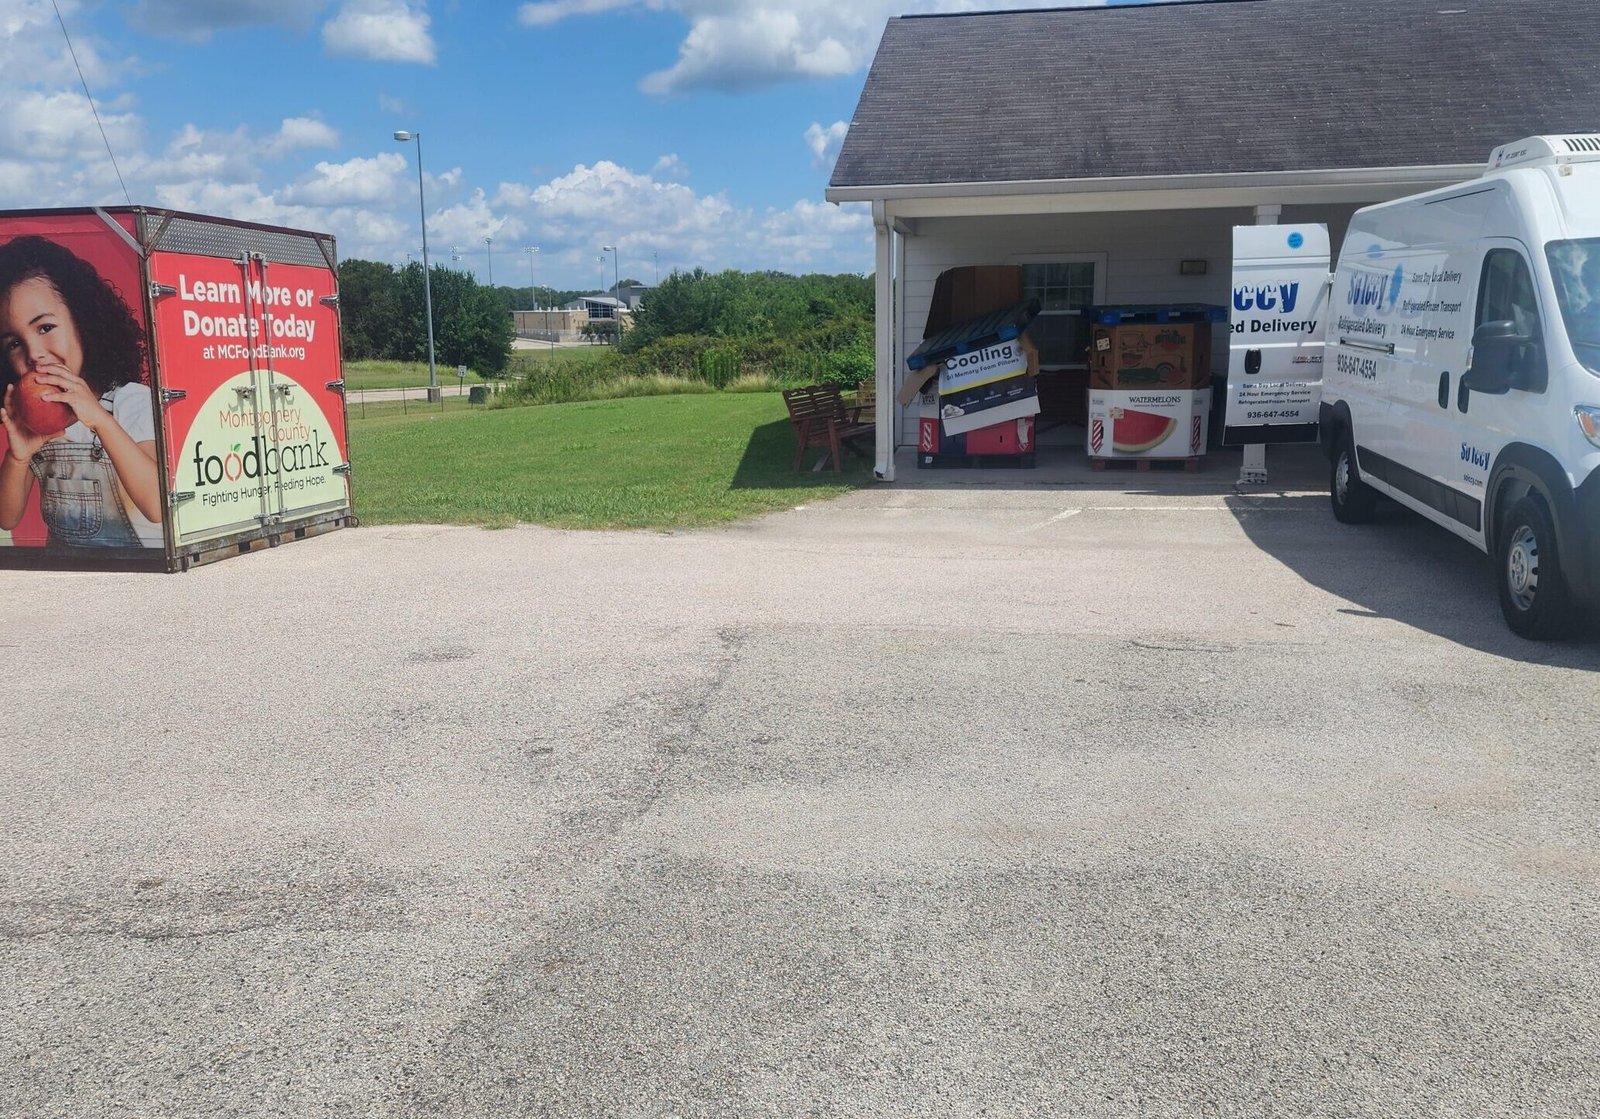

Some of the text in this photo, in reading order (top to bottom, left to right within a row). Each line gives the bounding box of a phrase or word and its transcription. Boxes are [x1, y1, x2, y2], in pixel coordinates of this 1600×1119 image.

[1443, 270, 1462, 285] Delivery
[179, 274, 314, 308] Learn More or
[1440, 300, 1461, 315] Transport
[183, 309, 316, 342] Donate Today
[1250, 319, 1317, 334] Delivery
[1364, 318, 1386, 339] Delivery
[1415, 325, 1438, 341] Emergency
[1437, 326, 1455, 340] Service
[203, 344, 215, 359] at
[944, 345, 1013, 370] Cooling
[955, 367, 979, 378] Memory
[979, 363, 997, 372] Foam
[997, 358, 1020, 367] Pillows
[1337, 353, 1377, 381] 936-647-4554
[1129, 396, 1181, 404] WATERMELONS
[220, 407, 302, 430] Montgomery
[1247, 410, 1300, 419] 936-647-4554
[268, 423, 312, 443] County
[1460, 441, 1471, 461] So
[202, 490, 239, 507] Fighting
[240, 484, 273, 499] Hunger.
[305, 474, 327, 490] Hope.
